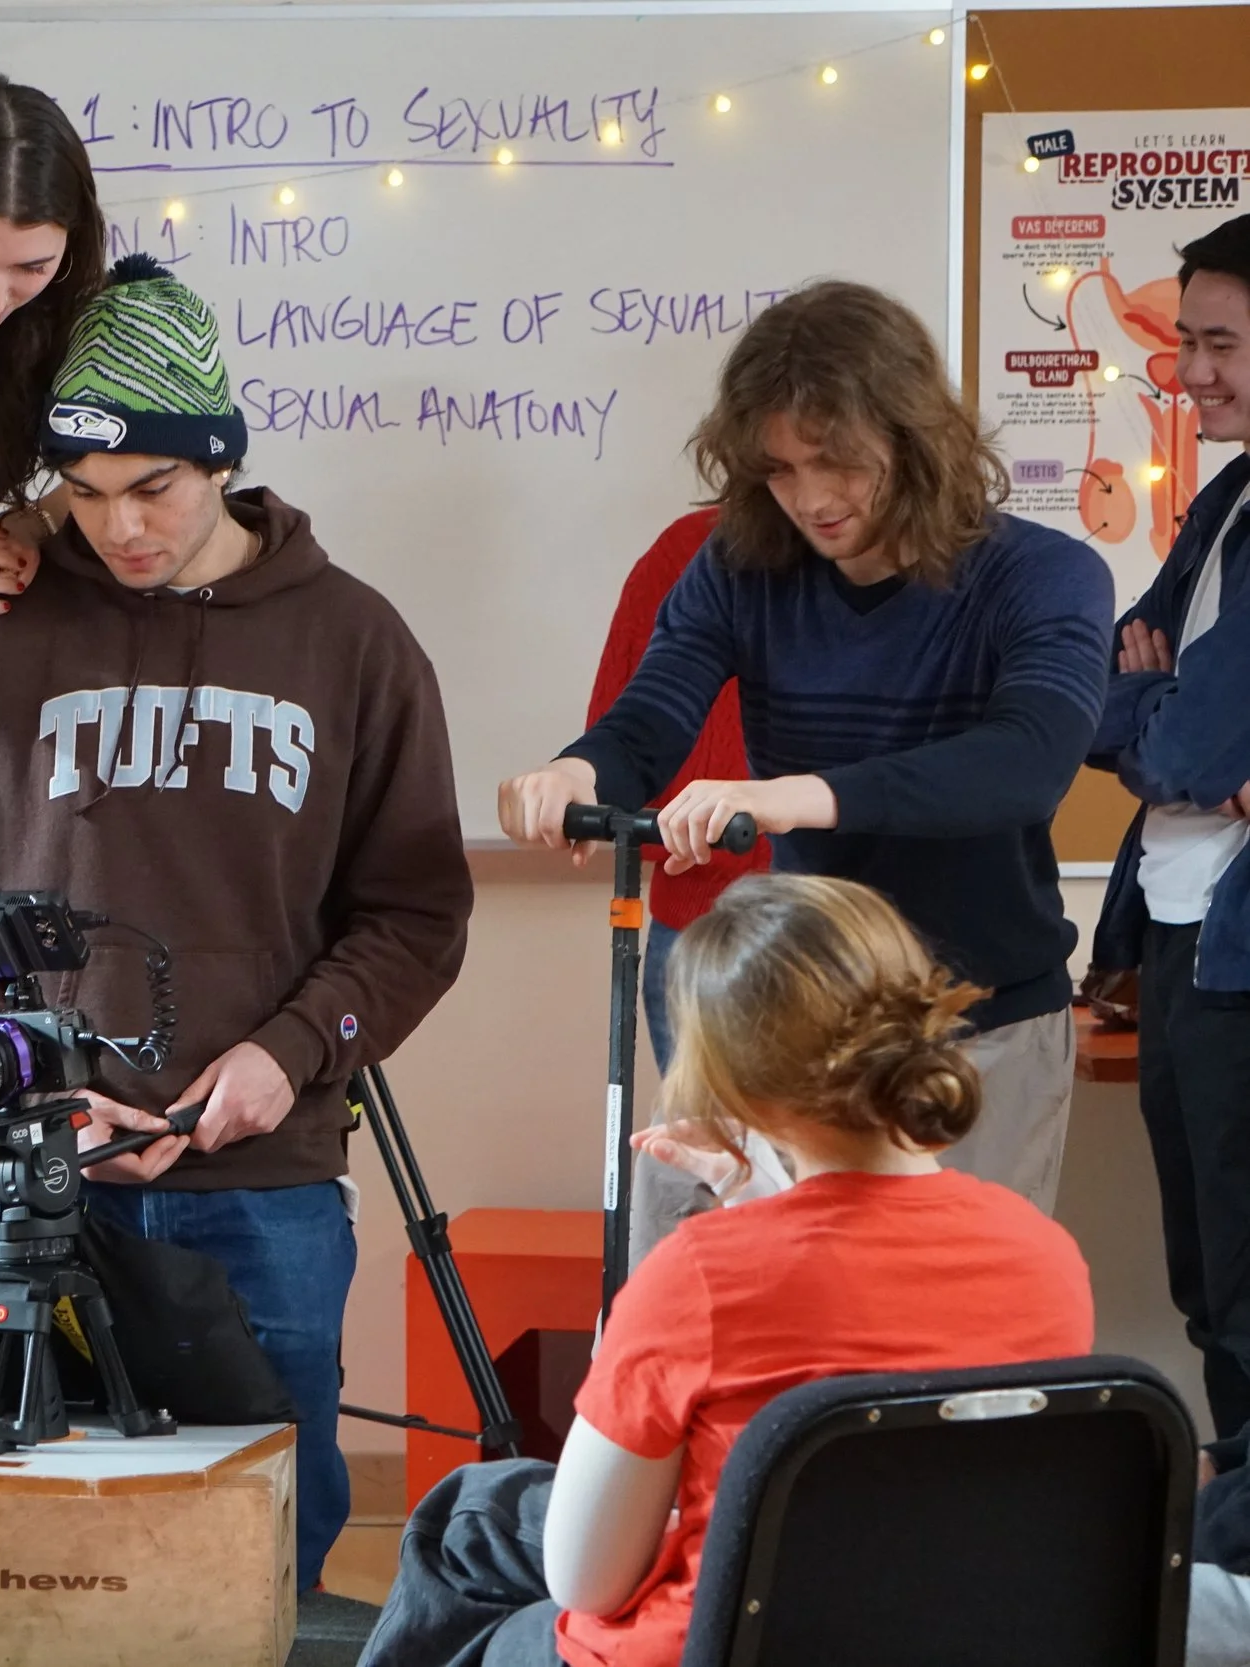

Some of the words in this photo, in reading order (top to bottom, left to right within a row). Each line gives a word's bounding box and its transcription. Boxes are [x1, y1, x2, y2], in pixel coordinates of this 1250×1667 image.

[152, 97, 288, 151] INTRO
[311, 97, 370, 158] TO
[404, 86, 667, 157] SEXUALITY
[1033, 134, 1068, 155] MALE
[1134, 134, 1174, 149] LET'S
[1181, 133, 1226, 147] LEARN
[1112, 176, 1240, 210] SYSTEM
[230, 202, 350, 268] INTRO
[1017, 220, 1042, 235] VAS
[1044, 218, 1100, 235] DEFERENS
[236, 295, 478, 350] LANGUAGE
[503, 292, 563, 345] OF
[590, 288, 790, 345] SEXUALIT
[1010, 353, 1093, 367] BULBOURETHRAL
[1035, 370, 1069, 383] GLAND
[240, 379, 401, 440] SEXUAL
[417, 385, 618, 461] ANATOMY
[1019, 464, 1058, 479] TESTIS
[39, 684, 315, 814] TUFTS
